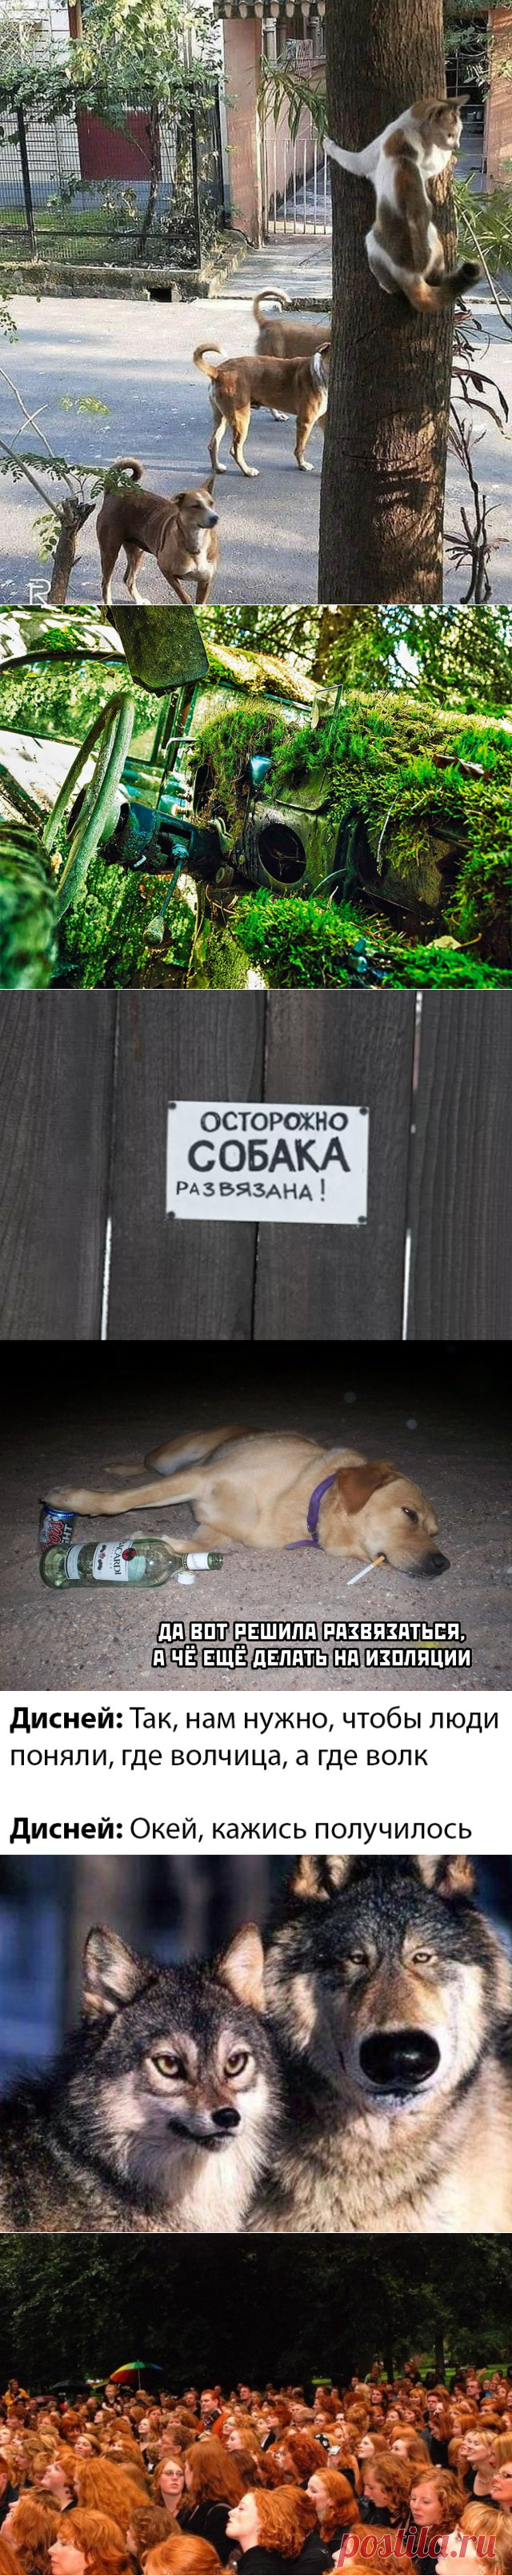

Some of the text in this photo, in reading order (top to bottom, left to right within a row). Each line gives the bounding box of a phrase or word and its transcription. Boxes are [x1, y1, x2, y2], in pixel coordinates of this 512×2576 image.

[200, 1111, 349, 1132] ОСТОРОЖНО
[188, 1136, 351, 1173] СОБАКА
[175, 1181, 313, 1202] РАЗВЯЗАНА
